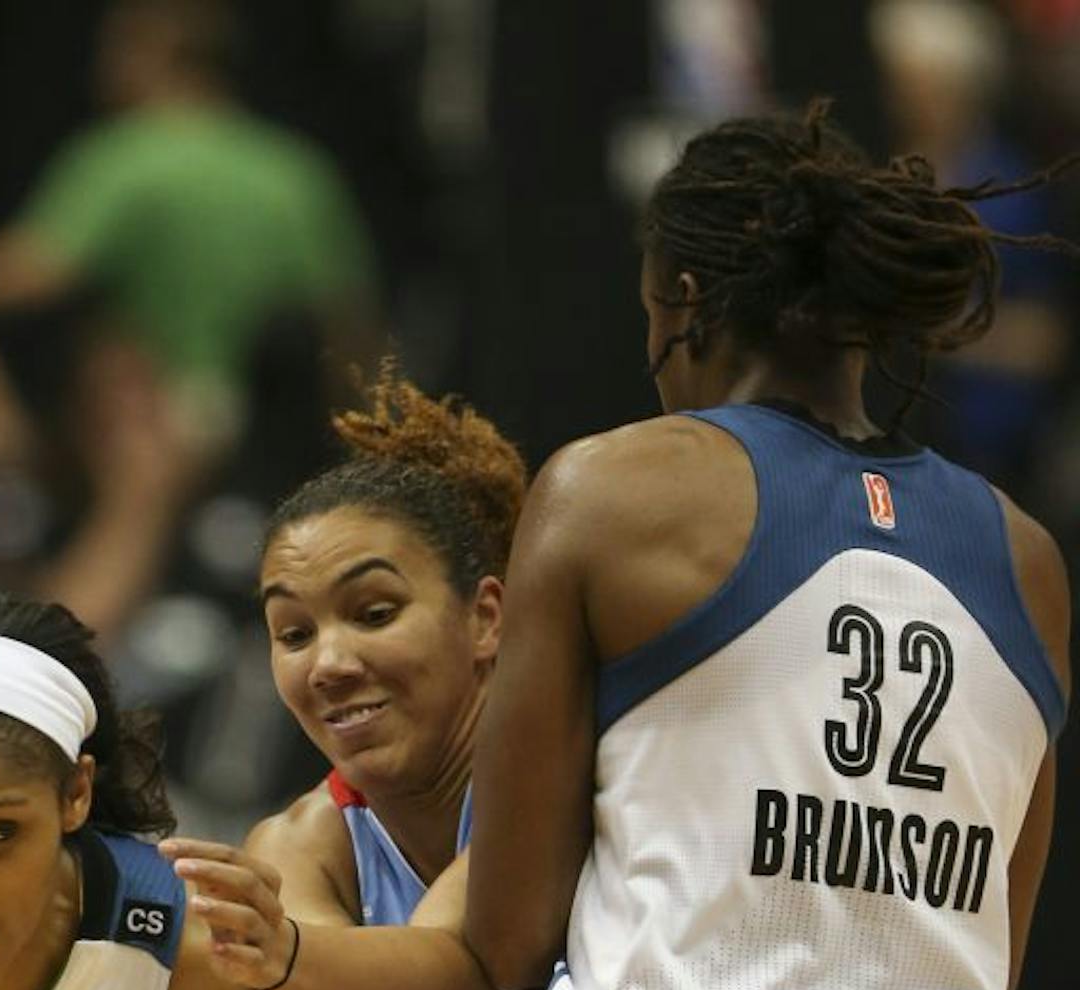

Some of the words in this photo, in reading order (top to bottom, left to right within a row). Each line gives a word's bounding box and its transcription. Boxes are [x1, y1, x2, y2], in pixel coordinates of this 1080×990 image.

[824, 603, 954, 792] 32
[750, 788, 994, 914] BRUNSON
[126, 907, 165, 935] CS
